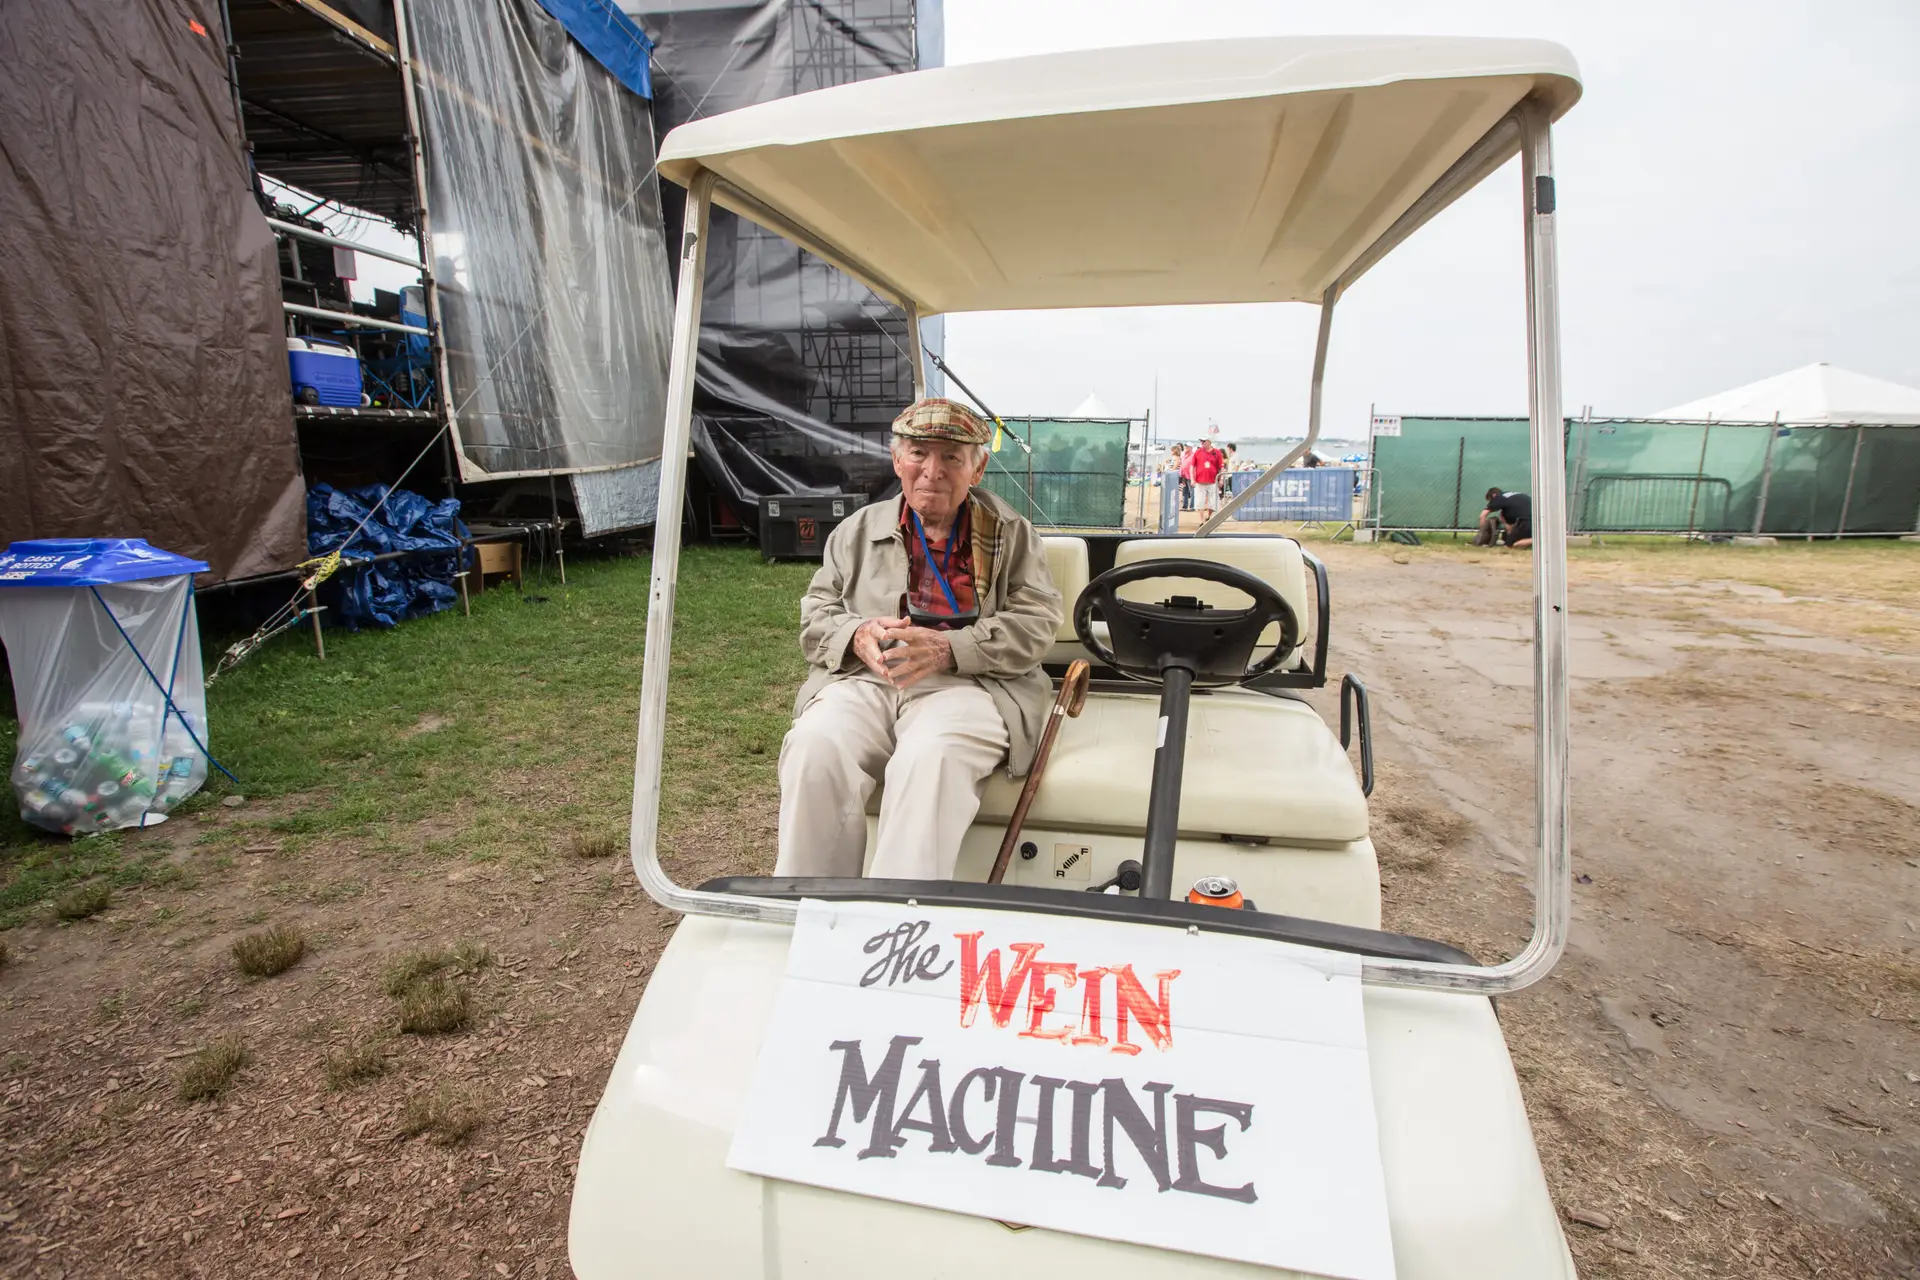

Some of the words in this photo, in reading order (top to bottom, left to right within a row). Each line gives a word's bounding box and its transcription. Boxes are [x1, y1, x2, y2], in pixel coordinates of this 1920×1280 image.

[1272, 480, 1310, 497] NFF
[1080, 847, 1089, 855] F
[860, 920, 953, 987] The
[953, 930, 1182, 1057] WEIN
[813, 1035, 1259, 1204] MACHINE
